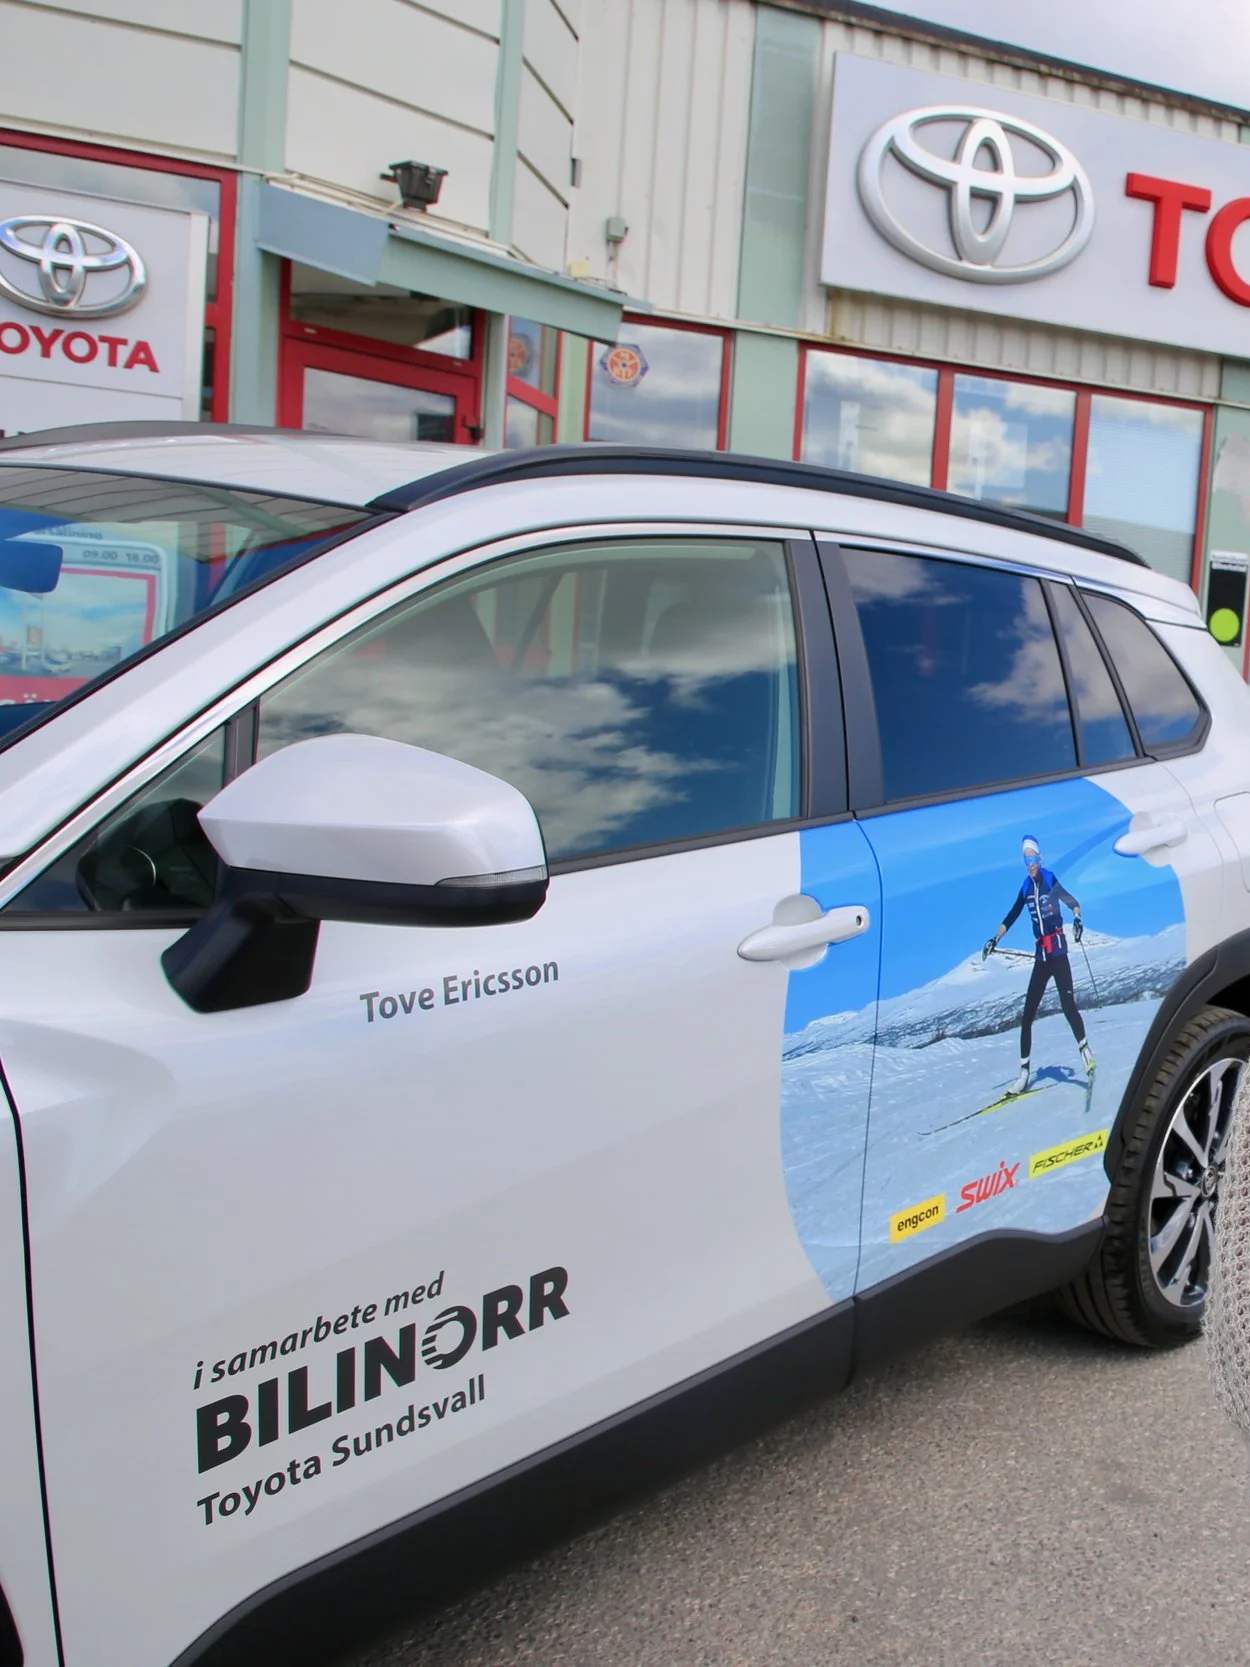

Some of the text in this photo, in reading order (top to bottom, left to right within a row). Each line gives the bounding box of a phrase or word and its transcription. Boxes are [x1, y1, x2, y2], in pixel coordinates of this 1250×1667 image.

[0, 321, 160, 374] OYOTA
[359, 961, 560, 1023] Tove Ericsson
[1032, 1140, 1094, 1173] FISCHER
[897, 1203, 940, 1232] engcon
[193, 1269, 446, 1390] i samarbete med
[196, 1266, 571, 1475] BILINORR
[197, 1373, 486, 1526] Toyota Sundsvall
